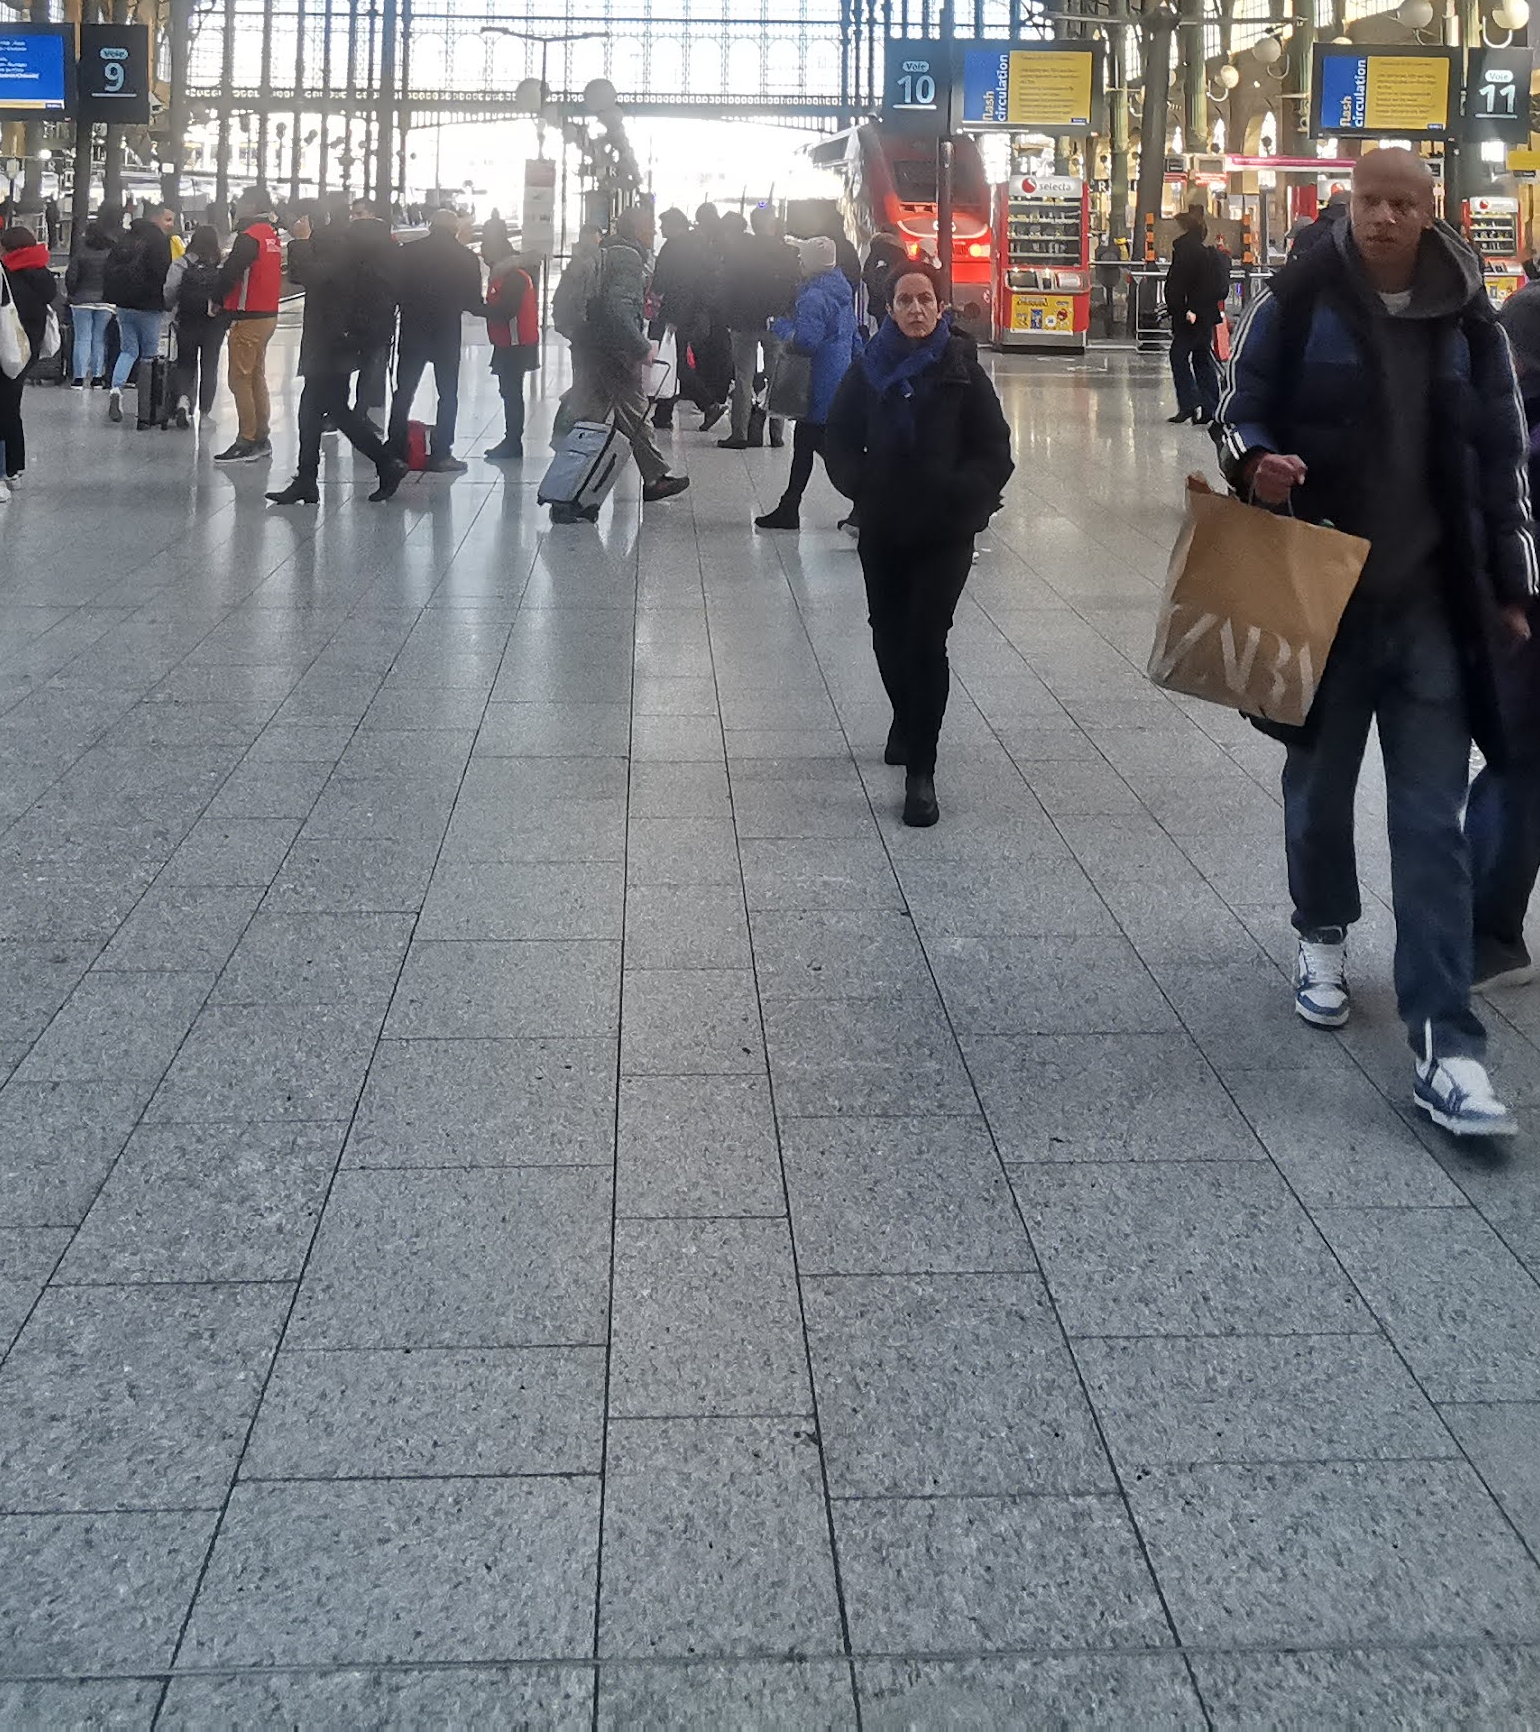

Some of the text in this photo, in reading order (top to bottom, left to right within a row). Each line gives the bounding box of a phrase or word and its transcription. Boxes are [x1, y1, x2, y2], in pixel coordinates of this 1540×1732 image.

[104, 62, 125, 92] 9
[905, 61, 927, 72] Voie
[1489, 72, 1509, 80] Voie
[896, 74, 936, 104] 10
[995, 54, 1009, 122] circulation
[1352, 59, 1366, 128] circulation
[1478, 83, 1516, 113] 11
[1038, 180, 1072, 192] selecta
